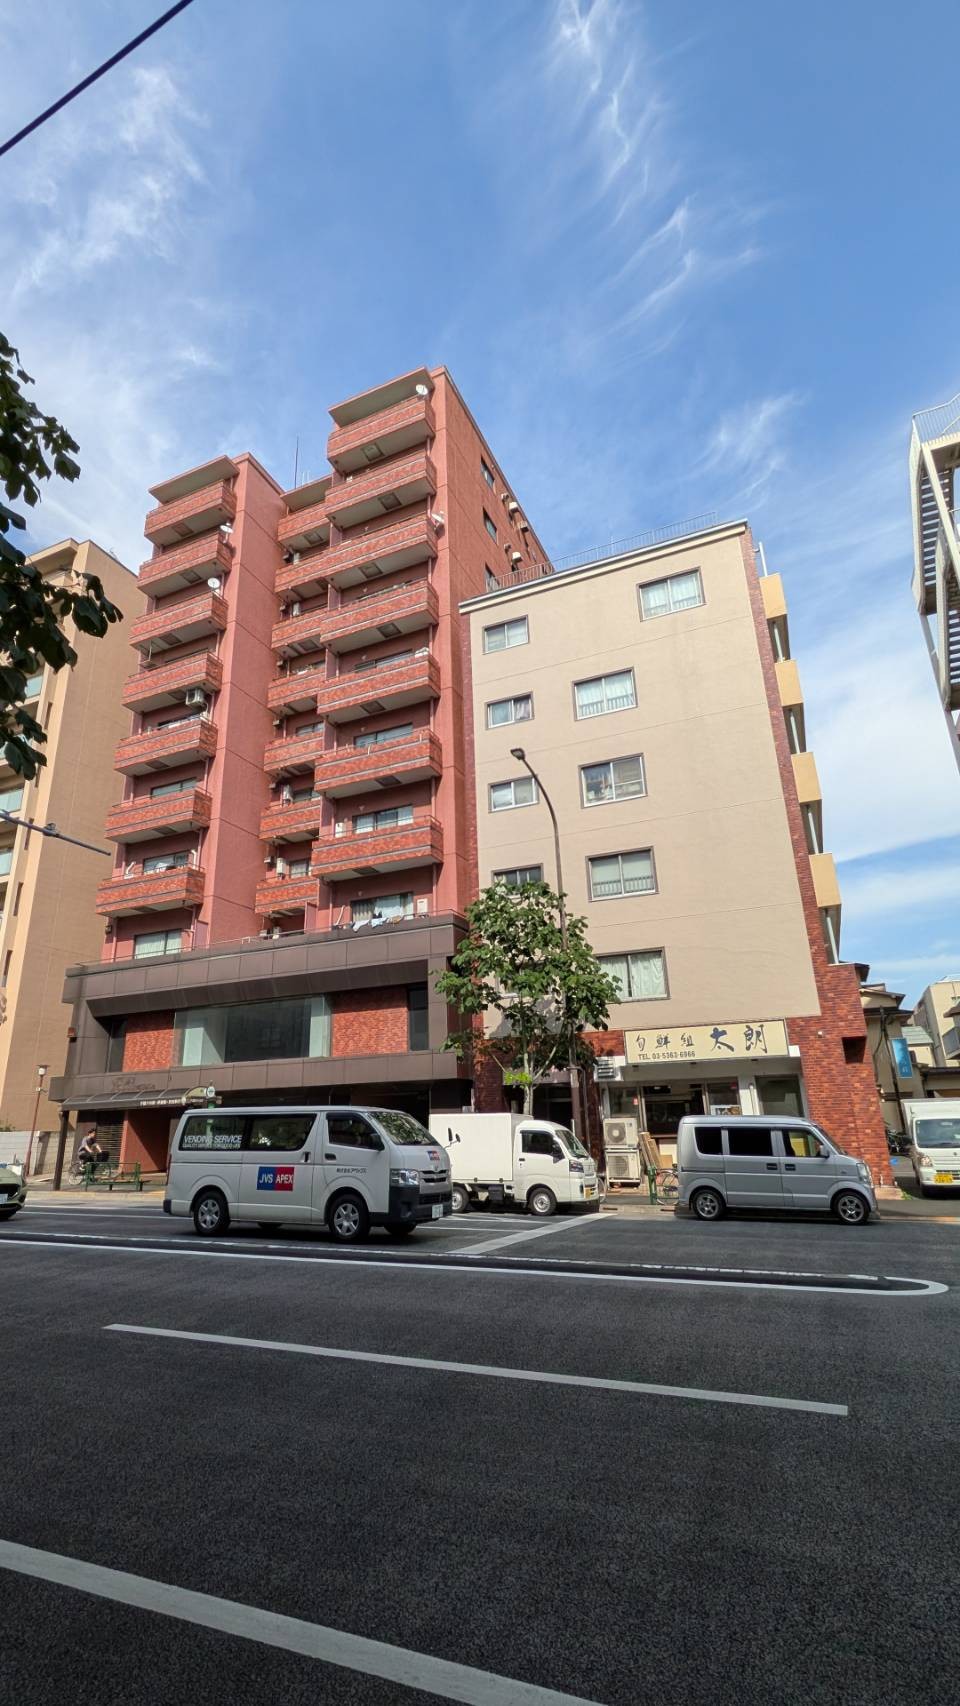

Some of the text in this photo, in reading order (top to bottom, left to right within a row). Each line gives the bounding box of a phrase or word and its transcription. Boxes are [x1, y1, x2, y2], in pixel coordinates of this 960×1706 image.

[184, 1135, 242, 1143] VENDING SERVICE
[259, 1173, 294, 1184] JVS APEX
